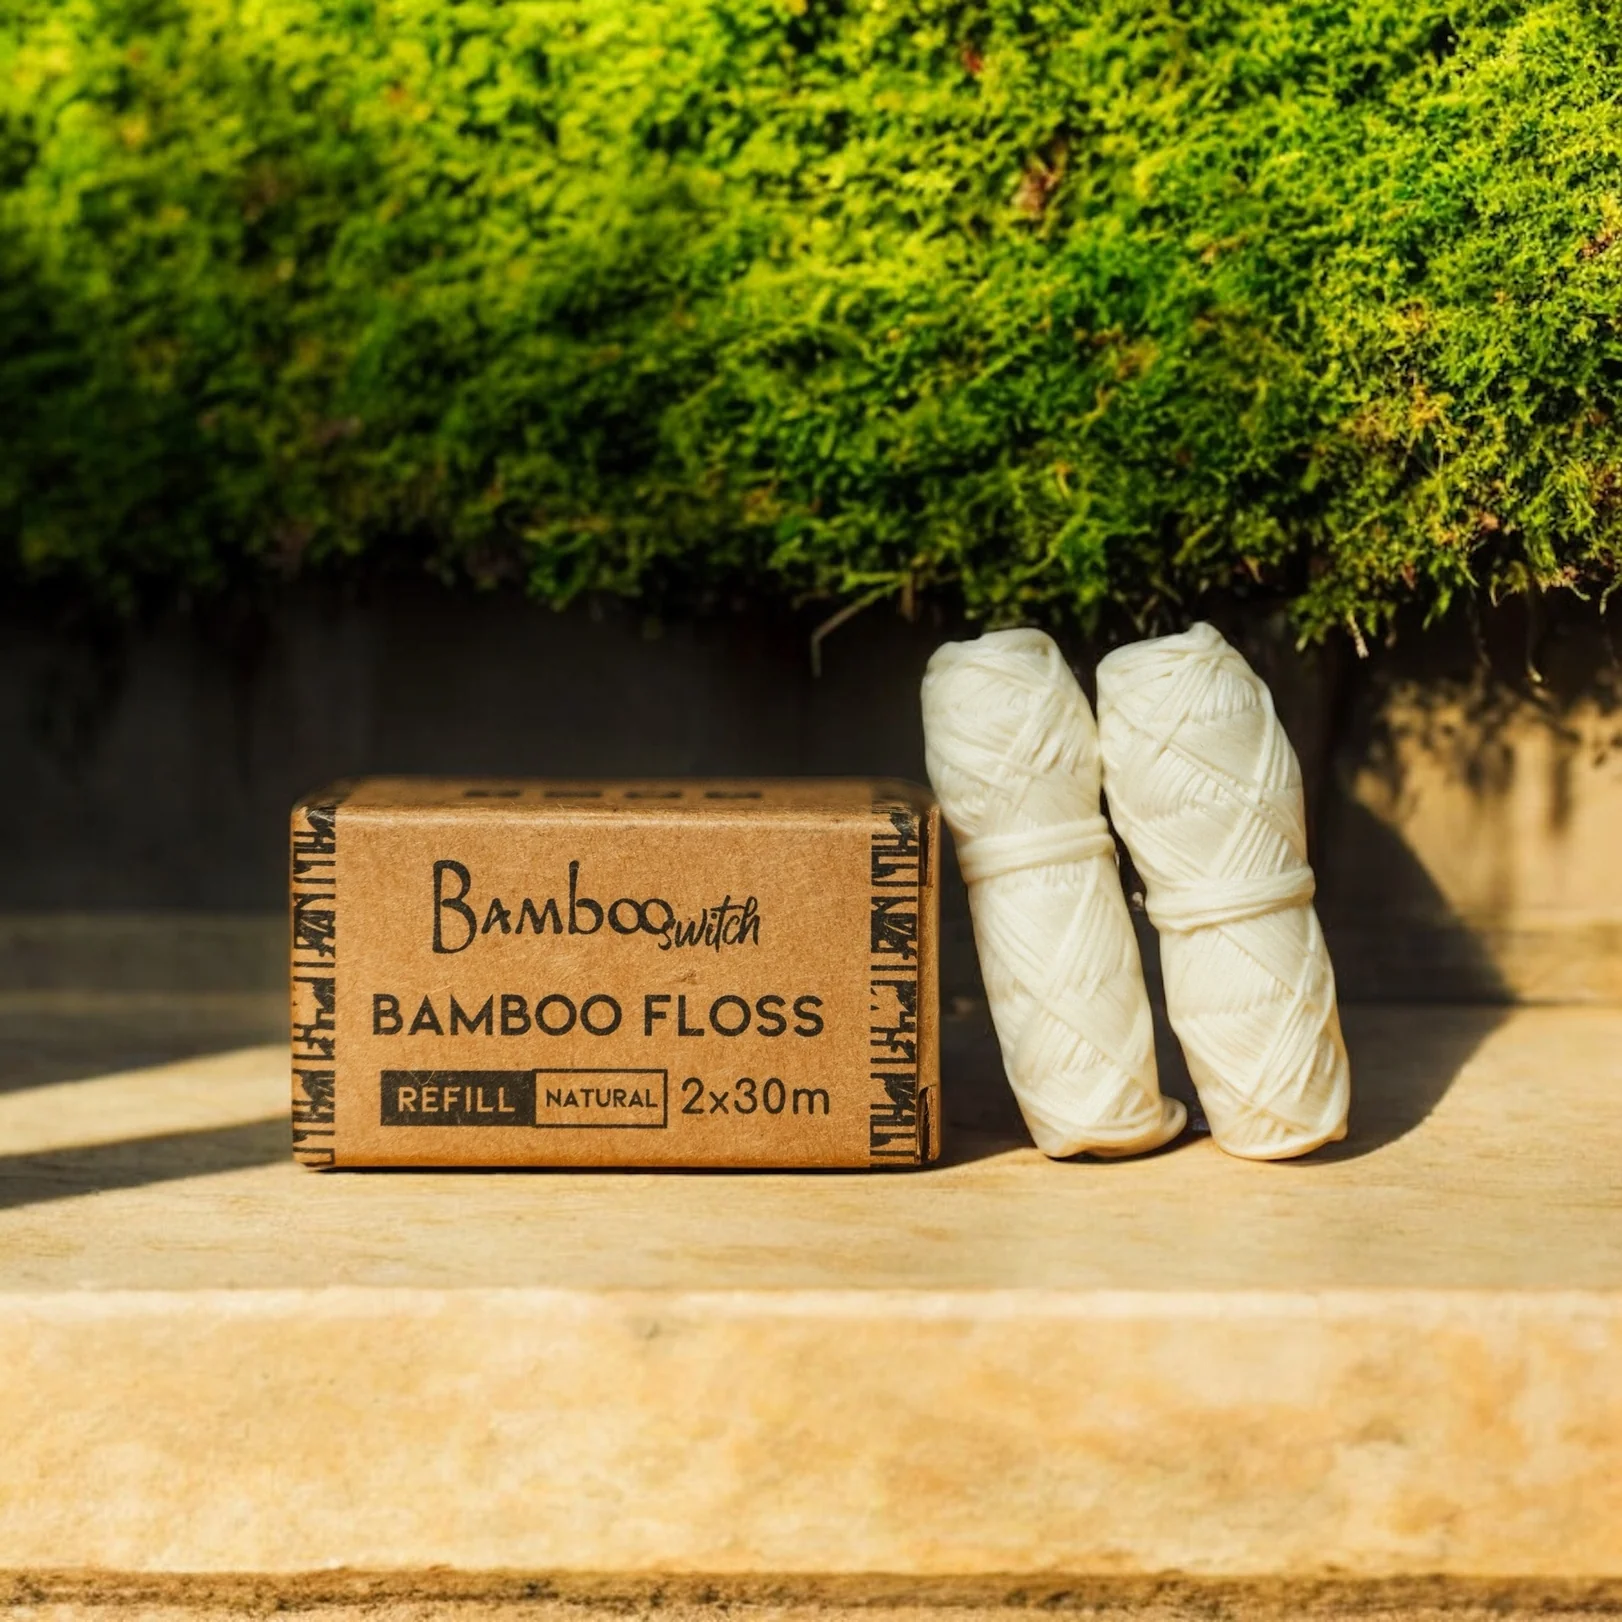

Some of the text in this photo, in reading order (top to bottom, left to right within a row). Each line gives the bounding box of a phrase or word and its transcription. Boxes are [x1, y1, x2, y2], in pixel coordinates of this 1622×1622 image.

[372, 993, 825, 1037] BAMBOO FLOSS
[396, 1077, 831, 1115] REFILL NATURAL 2x30m
